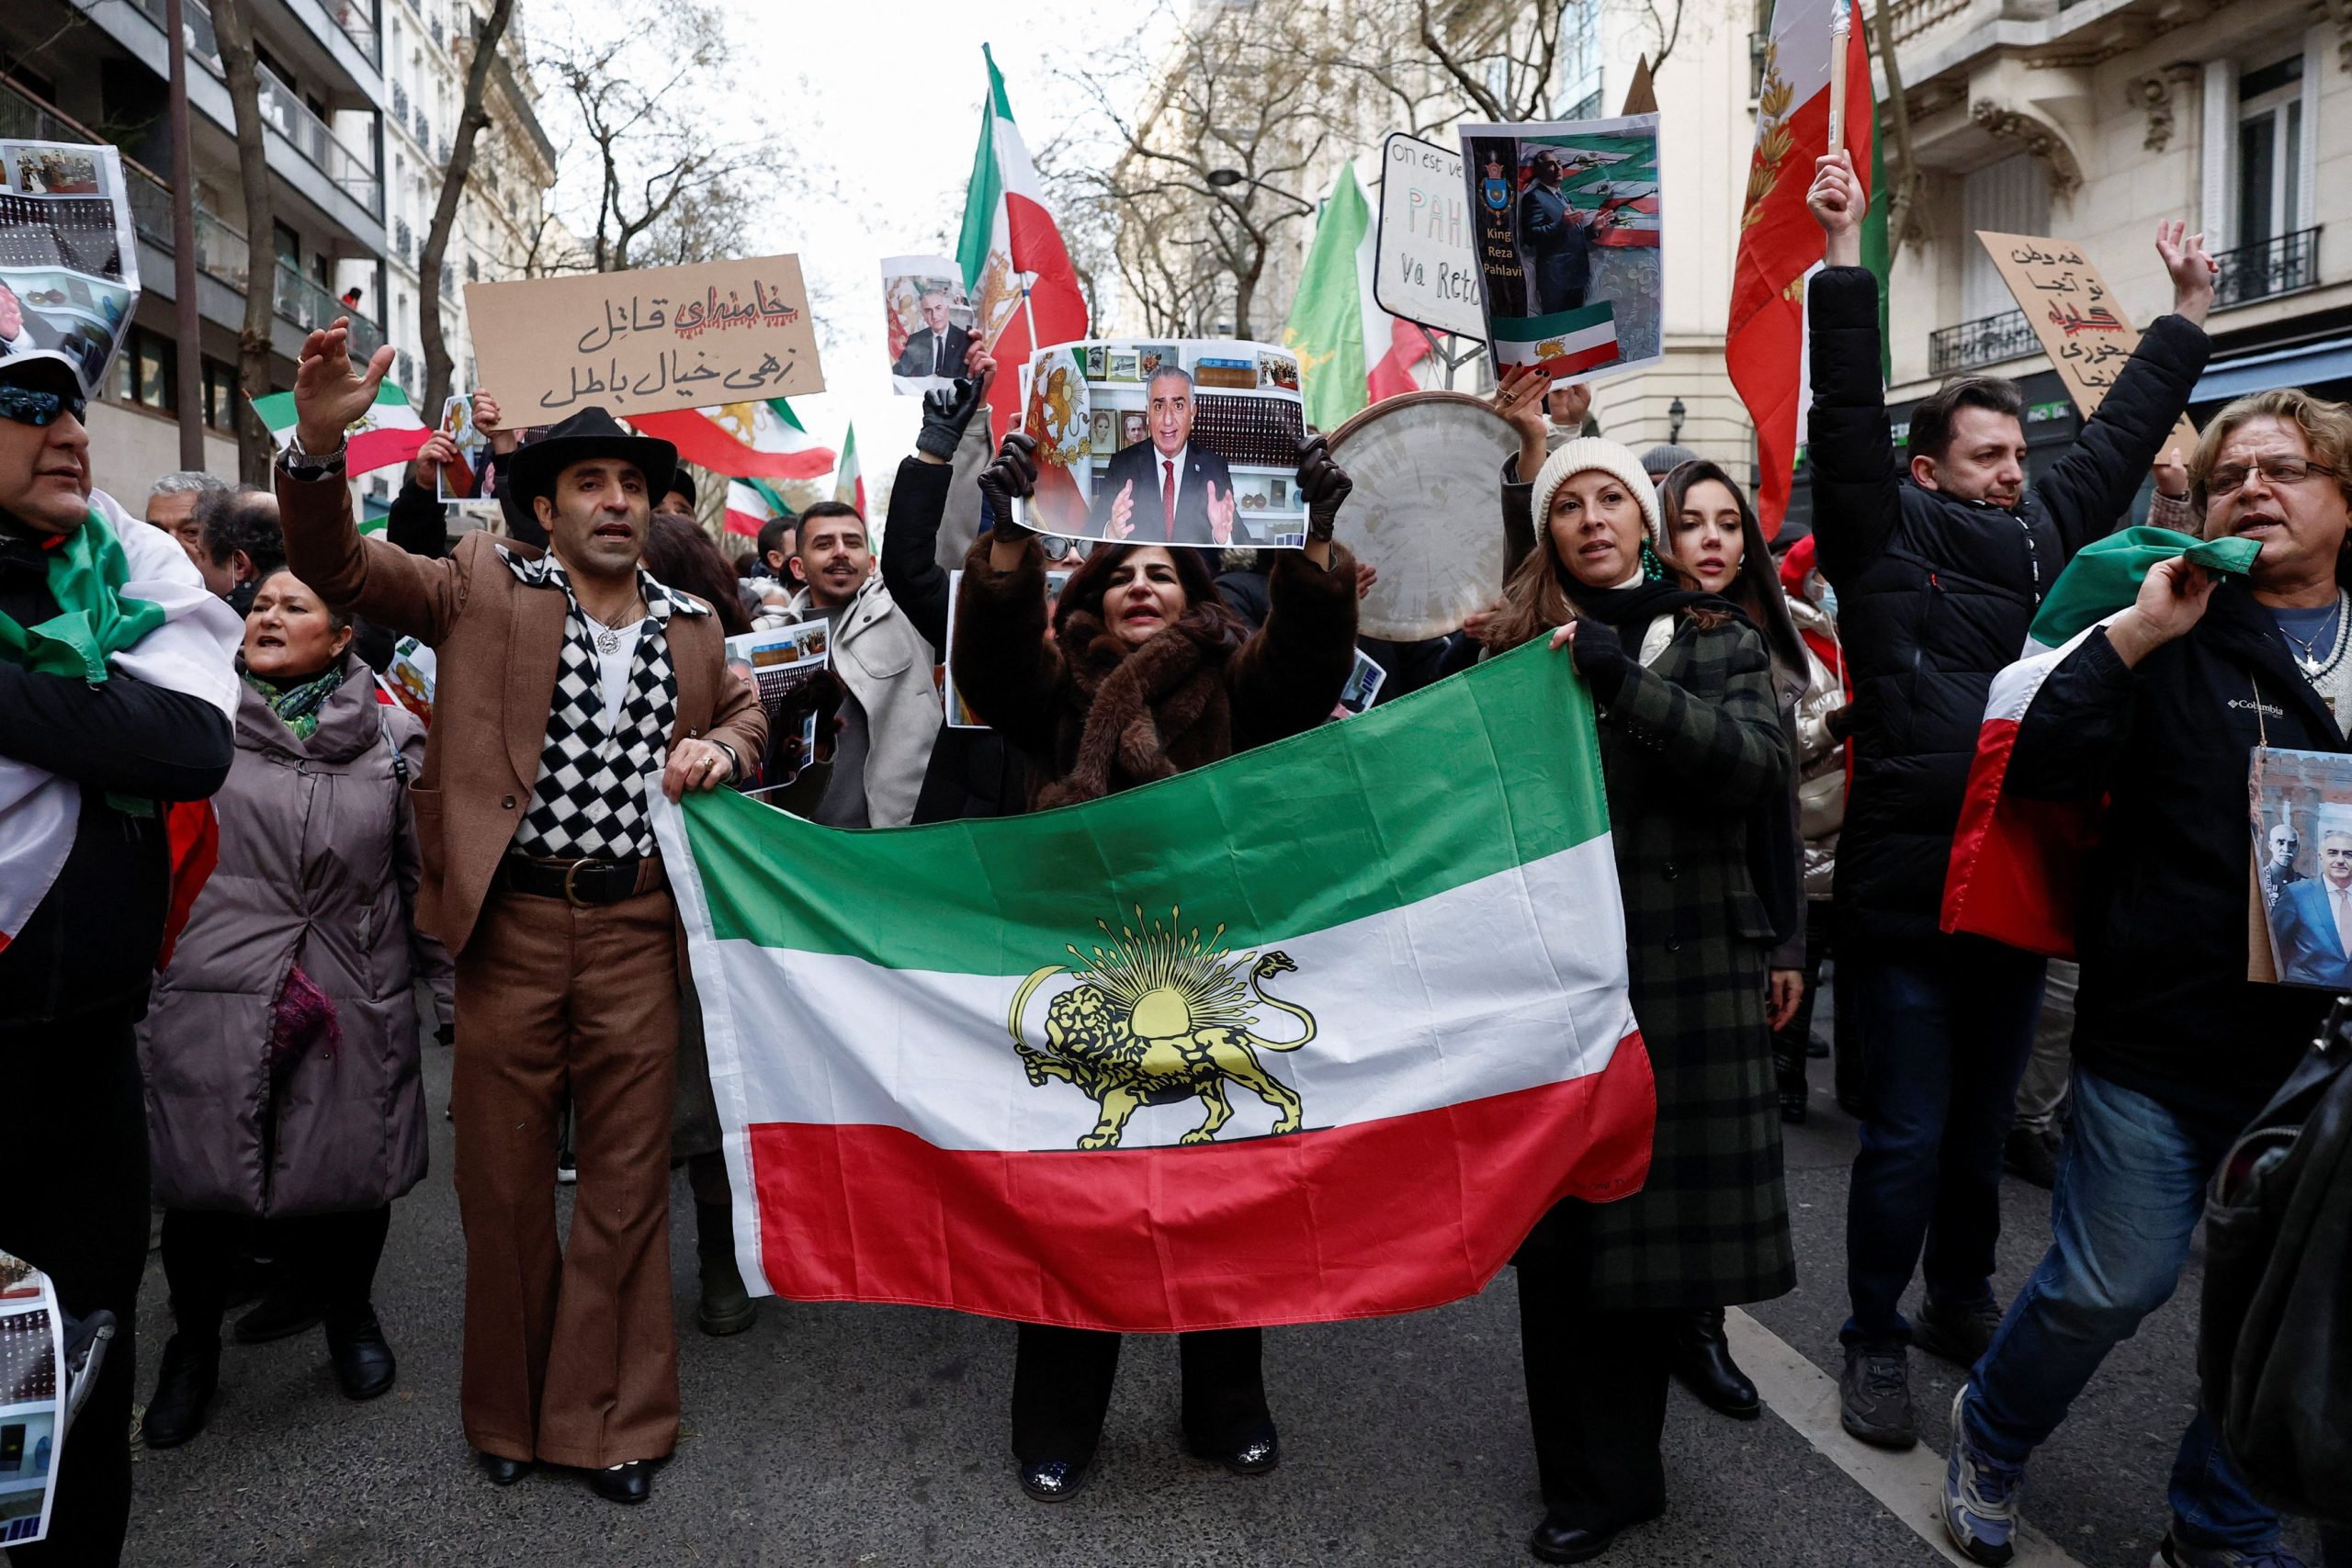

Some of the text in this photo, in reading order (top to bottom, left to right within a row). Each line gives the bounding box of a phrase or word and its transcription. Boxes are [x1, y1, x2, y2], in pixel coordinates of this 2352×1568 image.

[1487, 228, 1512, 243] King
[1487, 246, 1513, 259] Reza
[1484, 263, 1523, 277] Pahlavi
[632, 349, 720, 397] خیال
[539, 357, 628, 408] باطل
